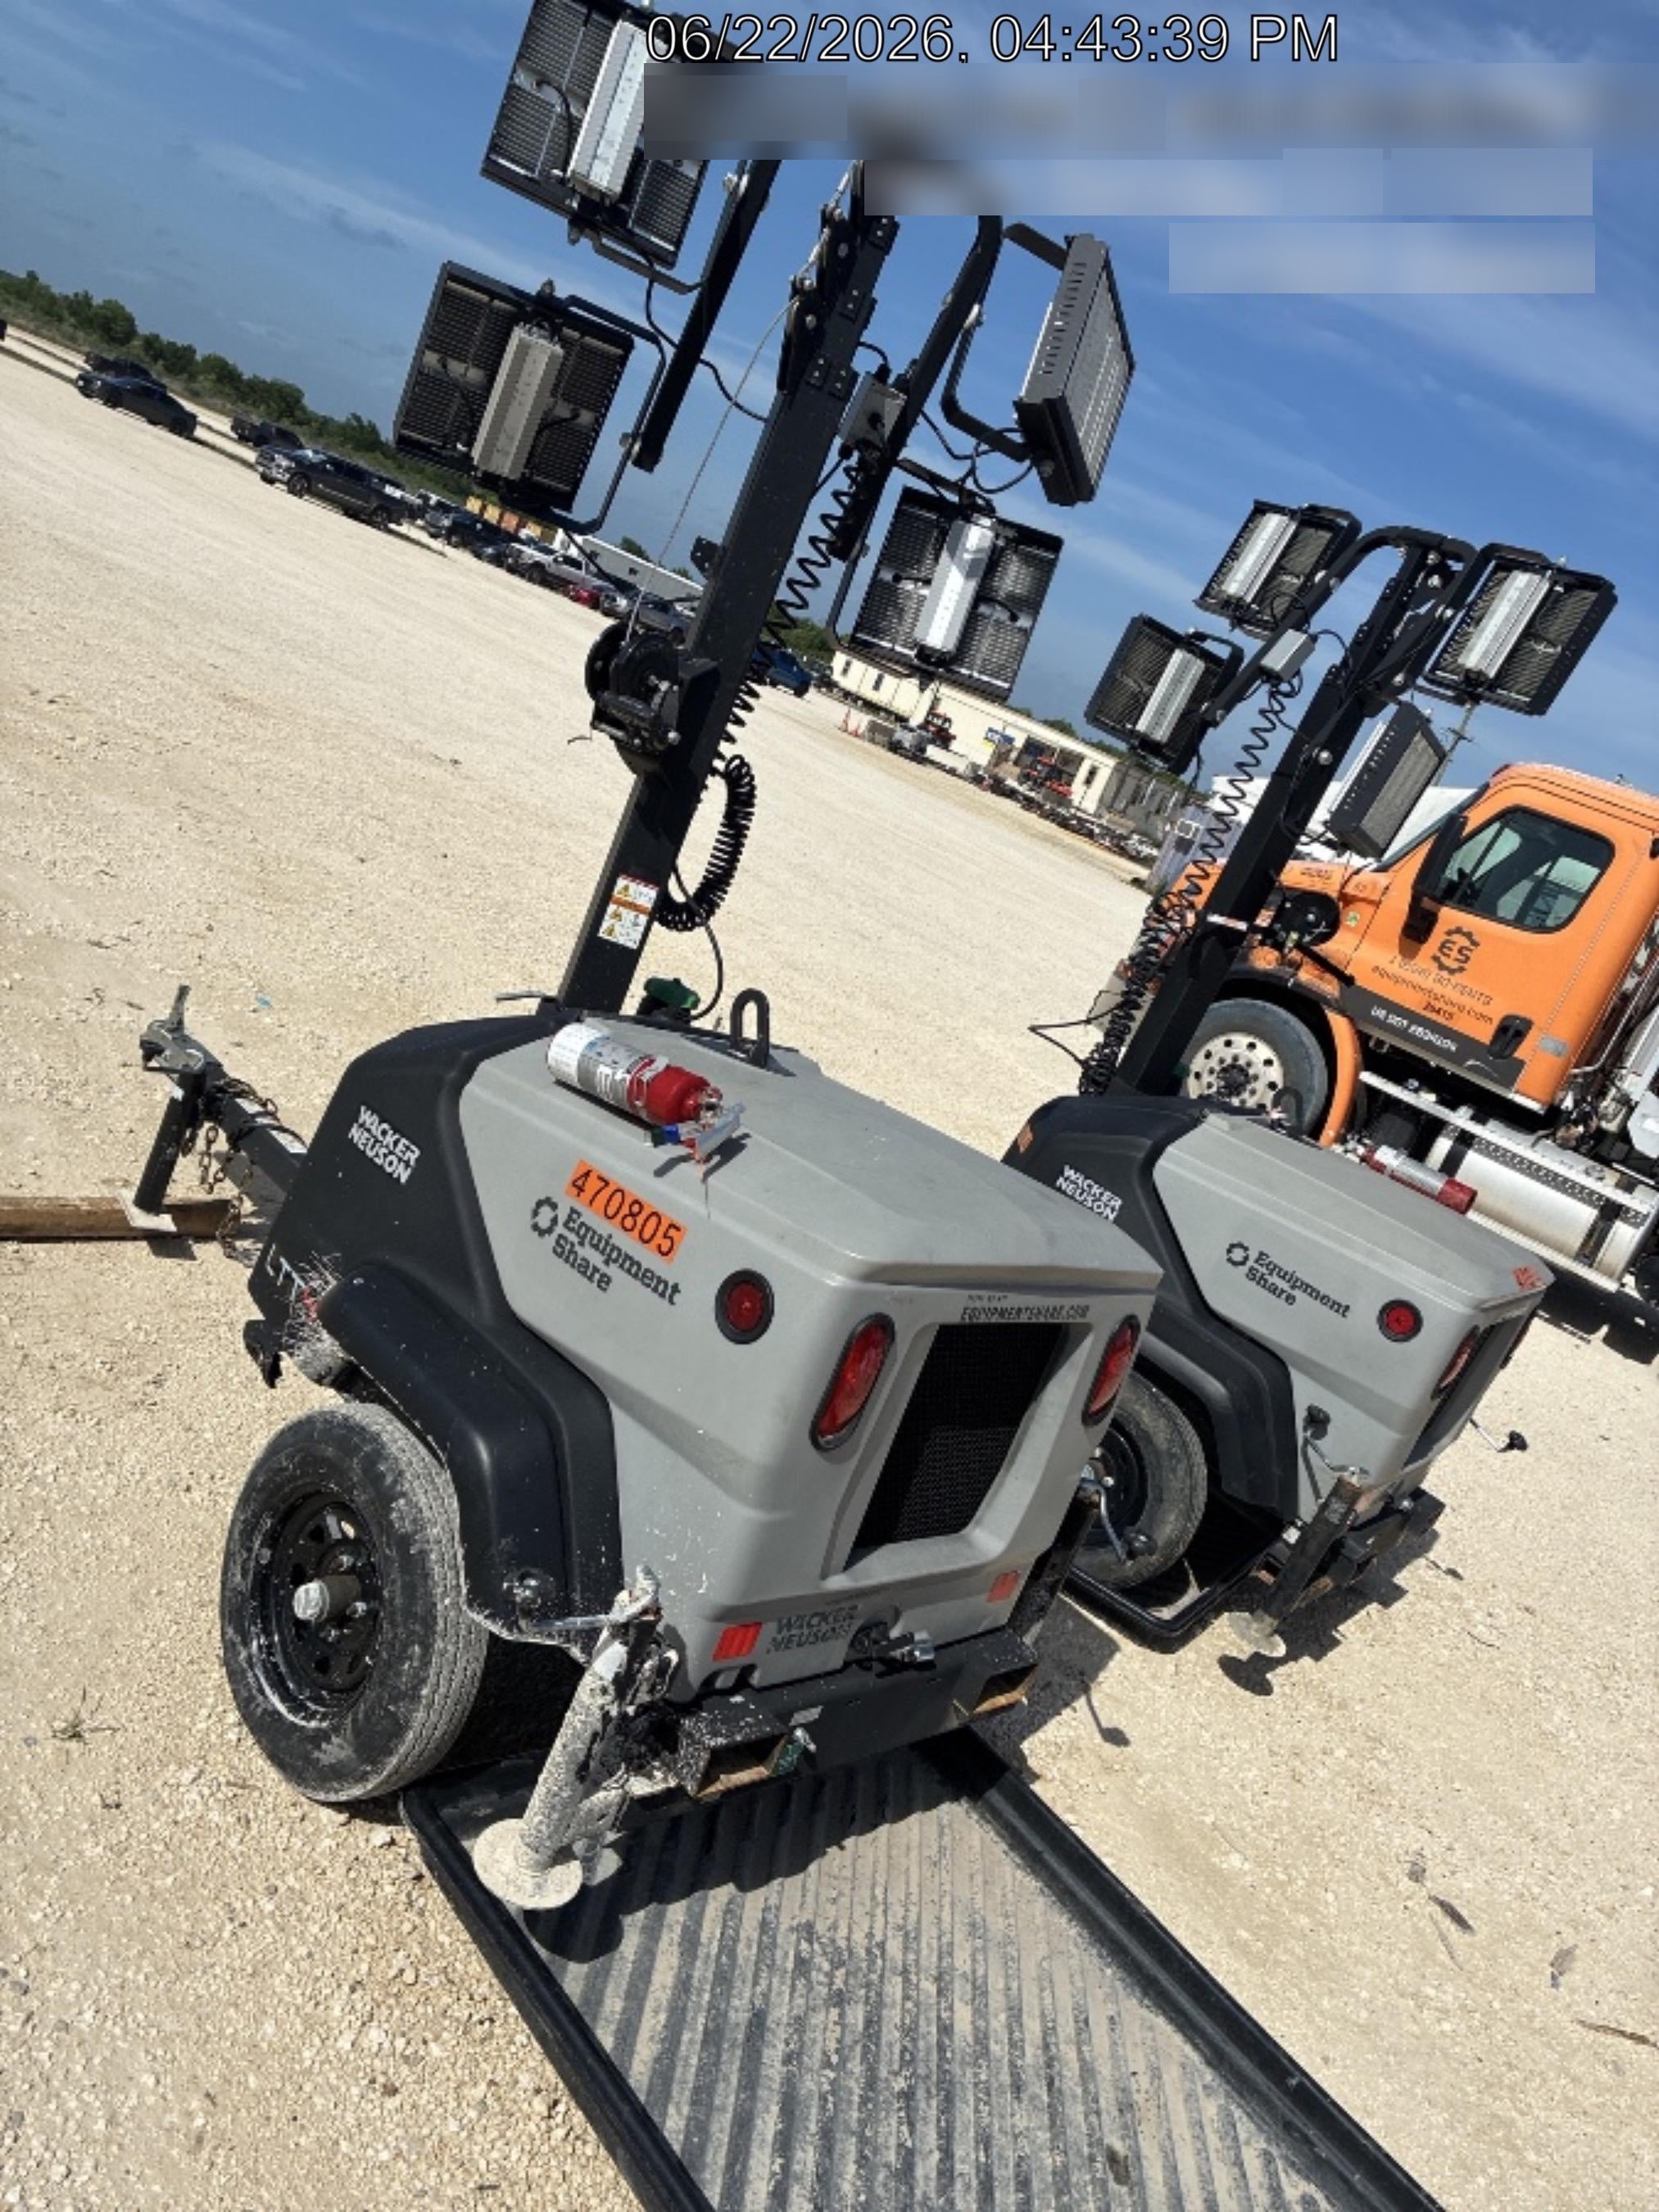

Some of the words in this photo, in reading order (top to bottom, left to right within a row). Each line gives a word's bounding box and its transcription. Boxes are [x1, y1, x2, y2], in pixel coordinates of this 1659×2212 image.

[1437, 939, 1474, 965] ES
[347, 1122, 414, 1185] NEUSON
[358, 1105, 421, 1167] WACKER
[572, 1168, 682, 1258] 470805
[1055, 1176, 1118, 1221] NEUSON
[1063, 1164, 1122, 1210] WACKER
[551, 1232, 613, 1293] Share
[562, 1205, 682, 1306] Equipment
[1244, 1265, 1297, 1307] Share
[1253, 1249, 1351, 1318] Equipment
